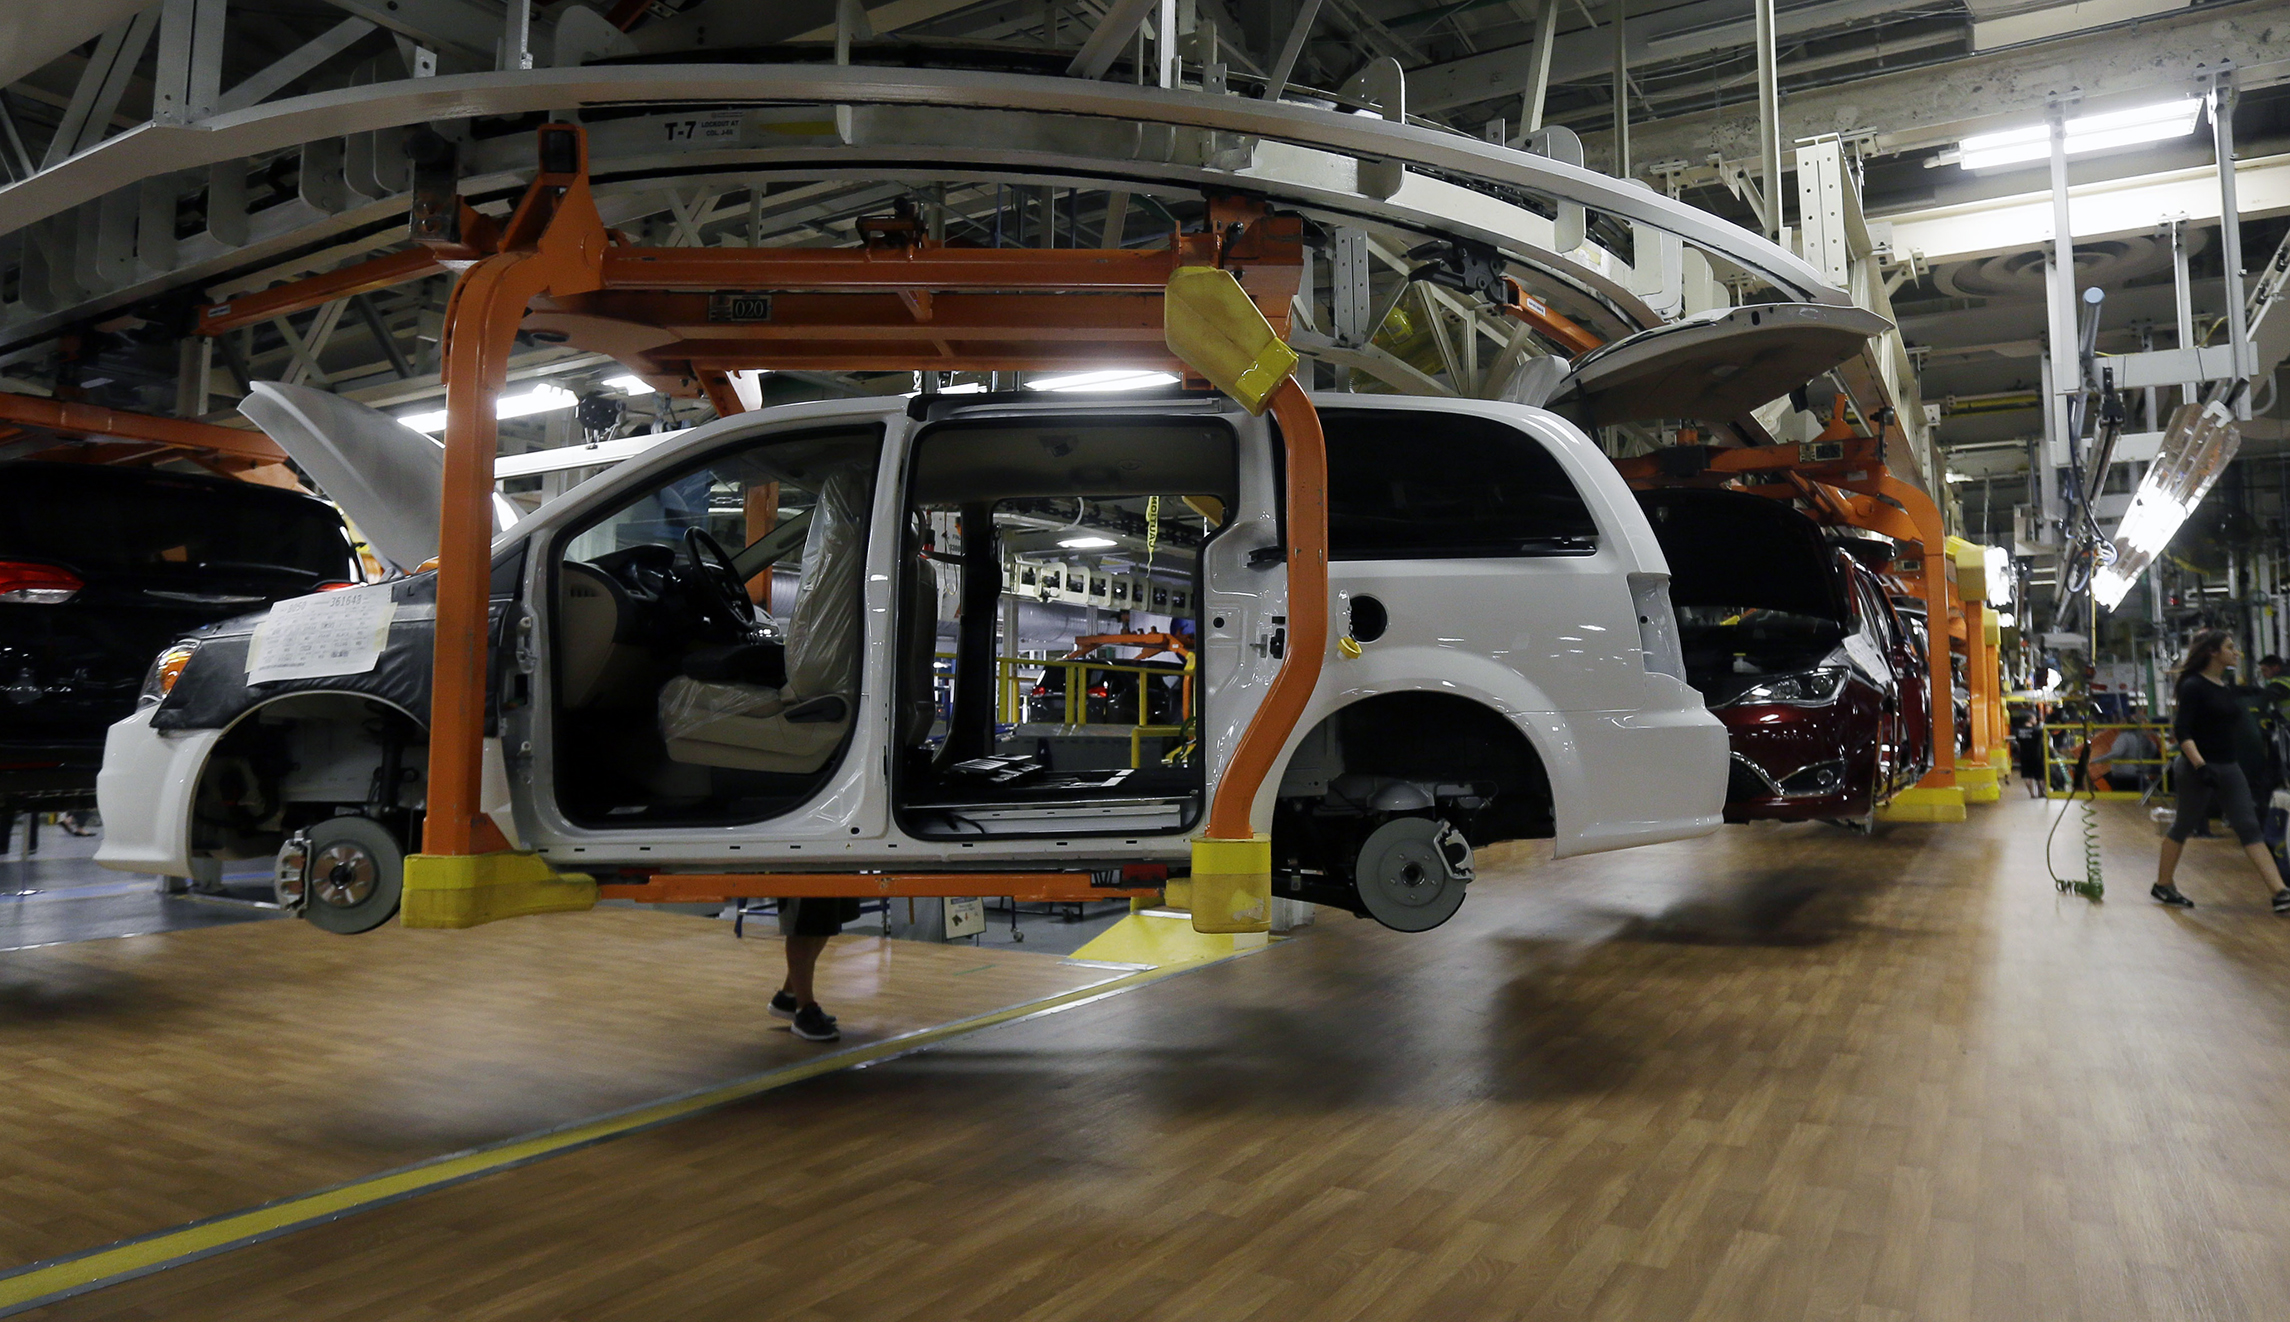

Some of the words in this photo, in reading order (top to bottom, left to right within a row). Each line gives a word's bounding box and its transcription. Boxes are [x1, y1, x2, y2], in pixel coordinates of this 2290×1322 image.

[664, 121, 697, 140] T-7
[701, 120, 730, 128] LOCKOUT
[735, 301, 764, 317] 020
